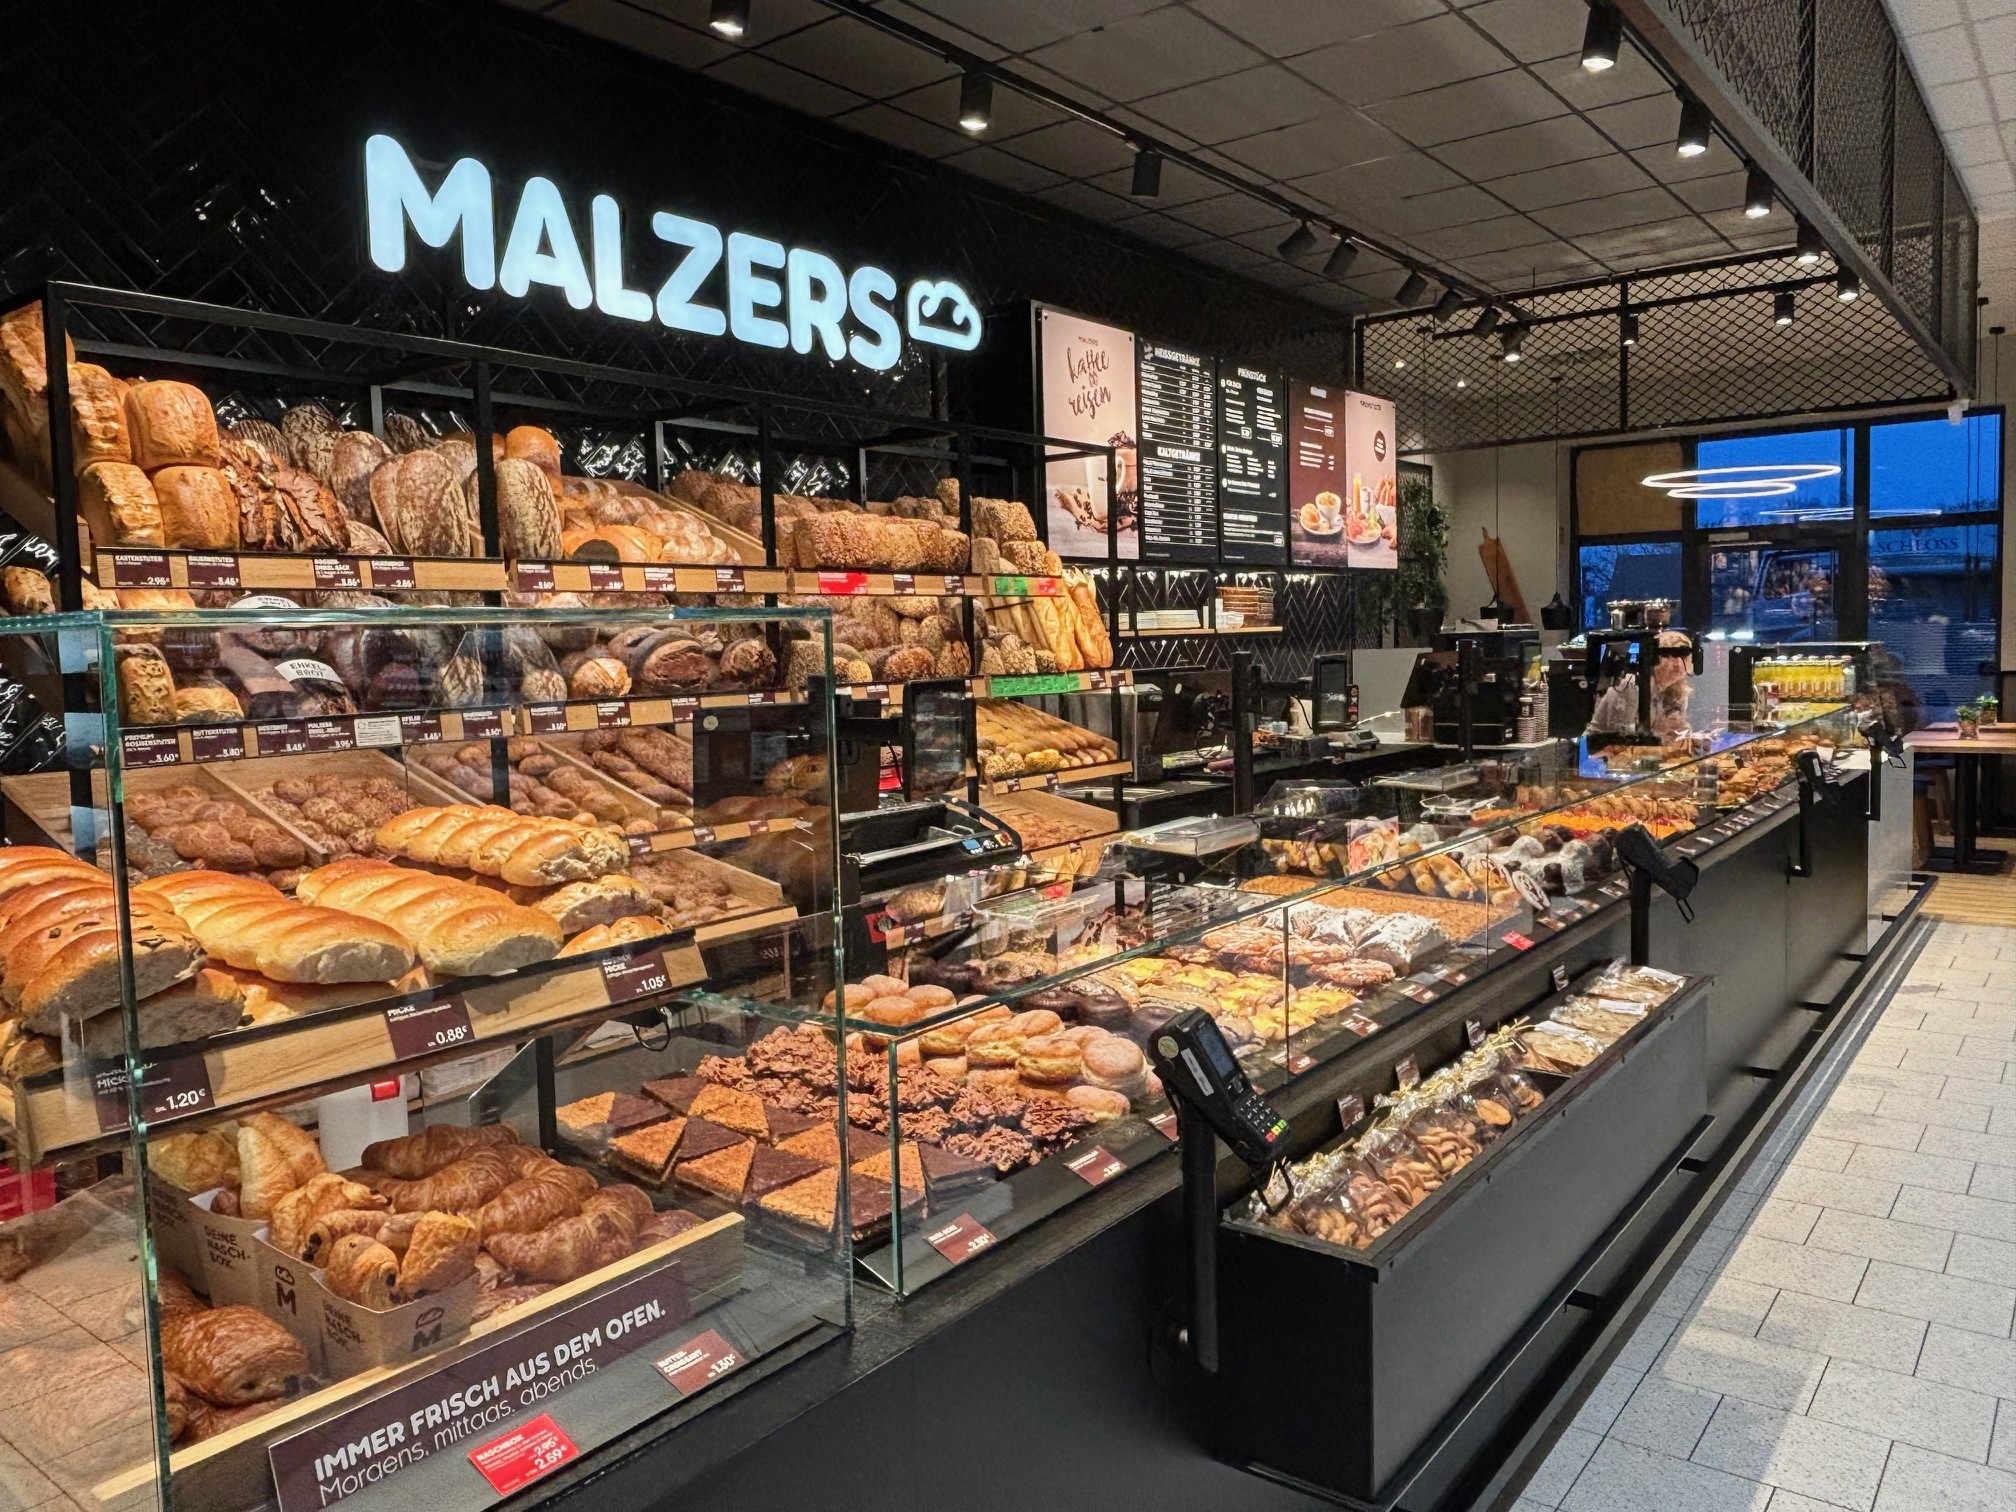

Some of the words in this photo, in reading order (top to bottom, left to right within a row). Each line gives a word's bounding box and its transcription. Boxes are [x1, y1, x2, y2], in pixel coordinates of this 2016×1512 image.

[365, 133, 902, 371] MALZERS
[641, 975, 667, 992] 1.05€
[436, 1025, 468, 1044] 0.88€
[166, 1088, 206, 1110] 1.20€
[314, 1421, 405, 1482] IMMER
[410, 1375, 500, 1437] FRISCH
[505, 1352, 550, 1390] AUS
[554, 1327, 602, 1367] DEM
[605, 1300, 666, 1340] OFEN.
